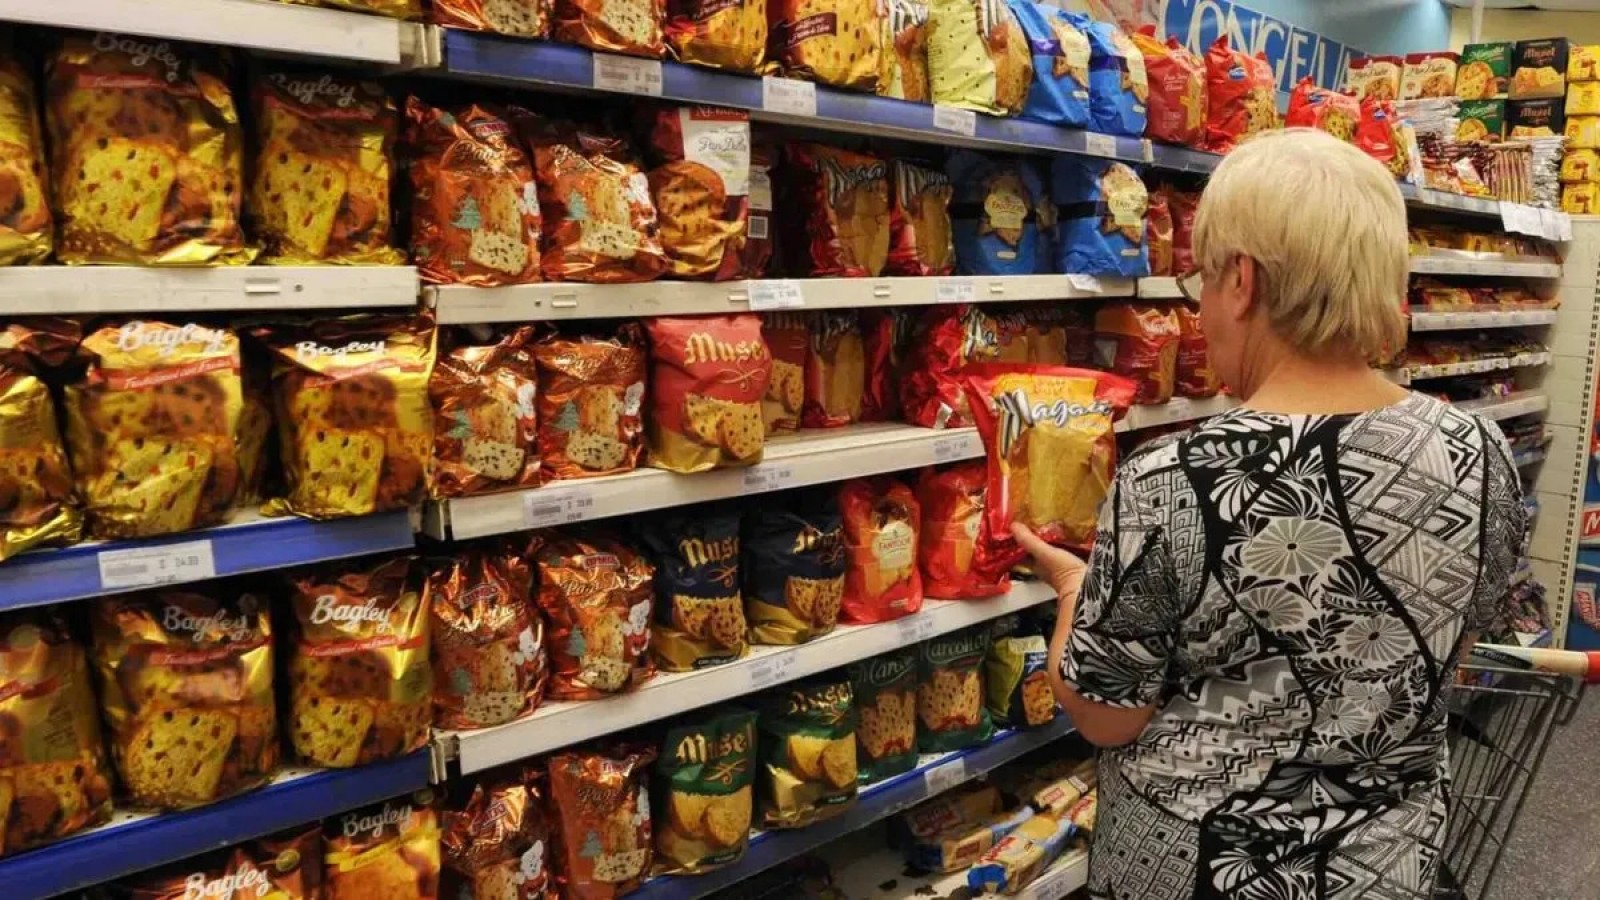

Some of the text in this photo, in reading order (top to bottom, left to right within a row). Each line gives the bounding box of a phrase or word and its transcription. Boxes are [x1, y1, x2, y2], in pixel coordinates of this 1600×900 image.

[118, 320, 226, 357] Bagley
[163, 606, 250, 642] Bagley
[311, 595, 393, 632] Bagley
[342, 803, 414, 839] Bagley
[183, 859, 274, 900] Bagley
